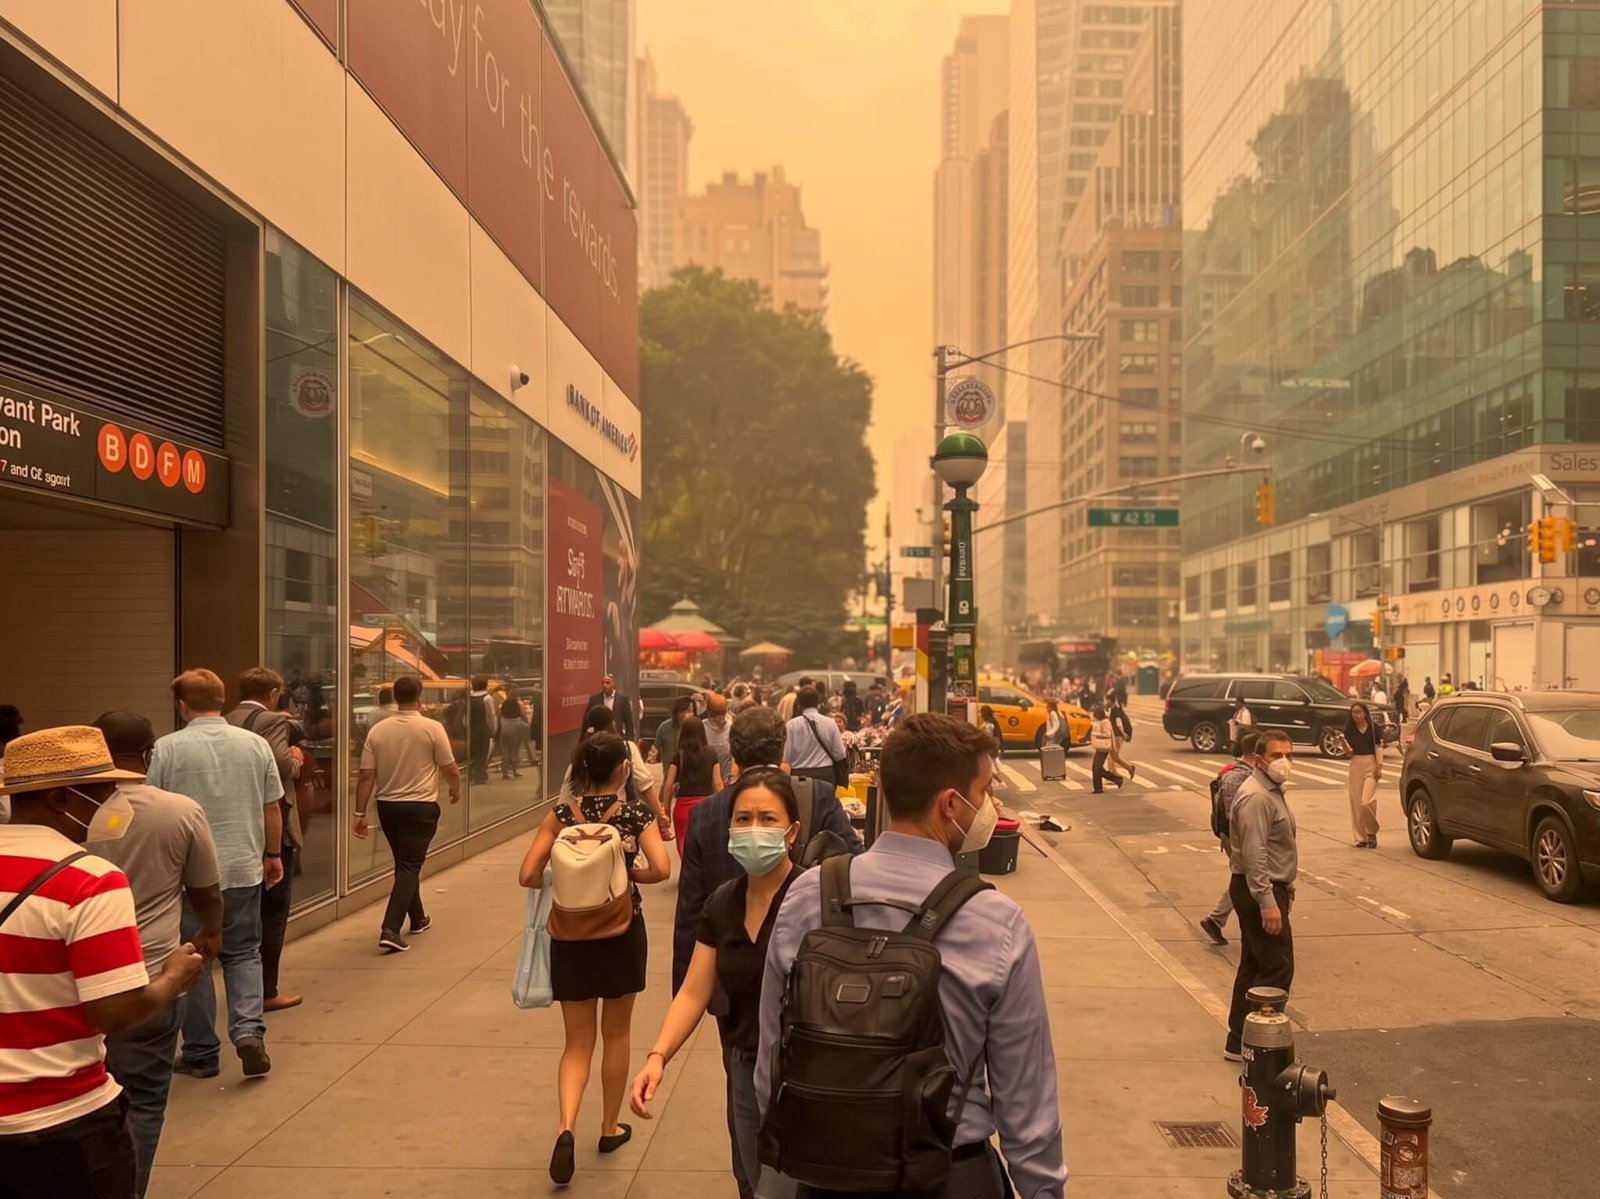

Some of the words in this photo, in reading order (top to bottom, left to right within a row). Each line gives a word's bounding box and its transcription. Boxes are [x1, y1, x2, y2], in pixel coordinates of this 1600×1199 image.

[472, 4, 511, 128] for
[520, 95, 554, 201] the
[41, 404, 81, 437] Park
[10, 464, 28, 478] and
[105, 433, 119, 462] B
[135, 443, 149, 469] D
[163, 452, 174, 476] F
[187, 458, 200, 484] M
[1550, 452, 1600, 471] Sales
[1110, 512, 1120, 523] W
[1124, 511, 1139, 524] 42
[1143, 511, 1156, 524] St
